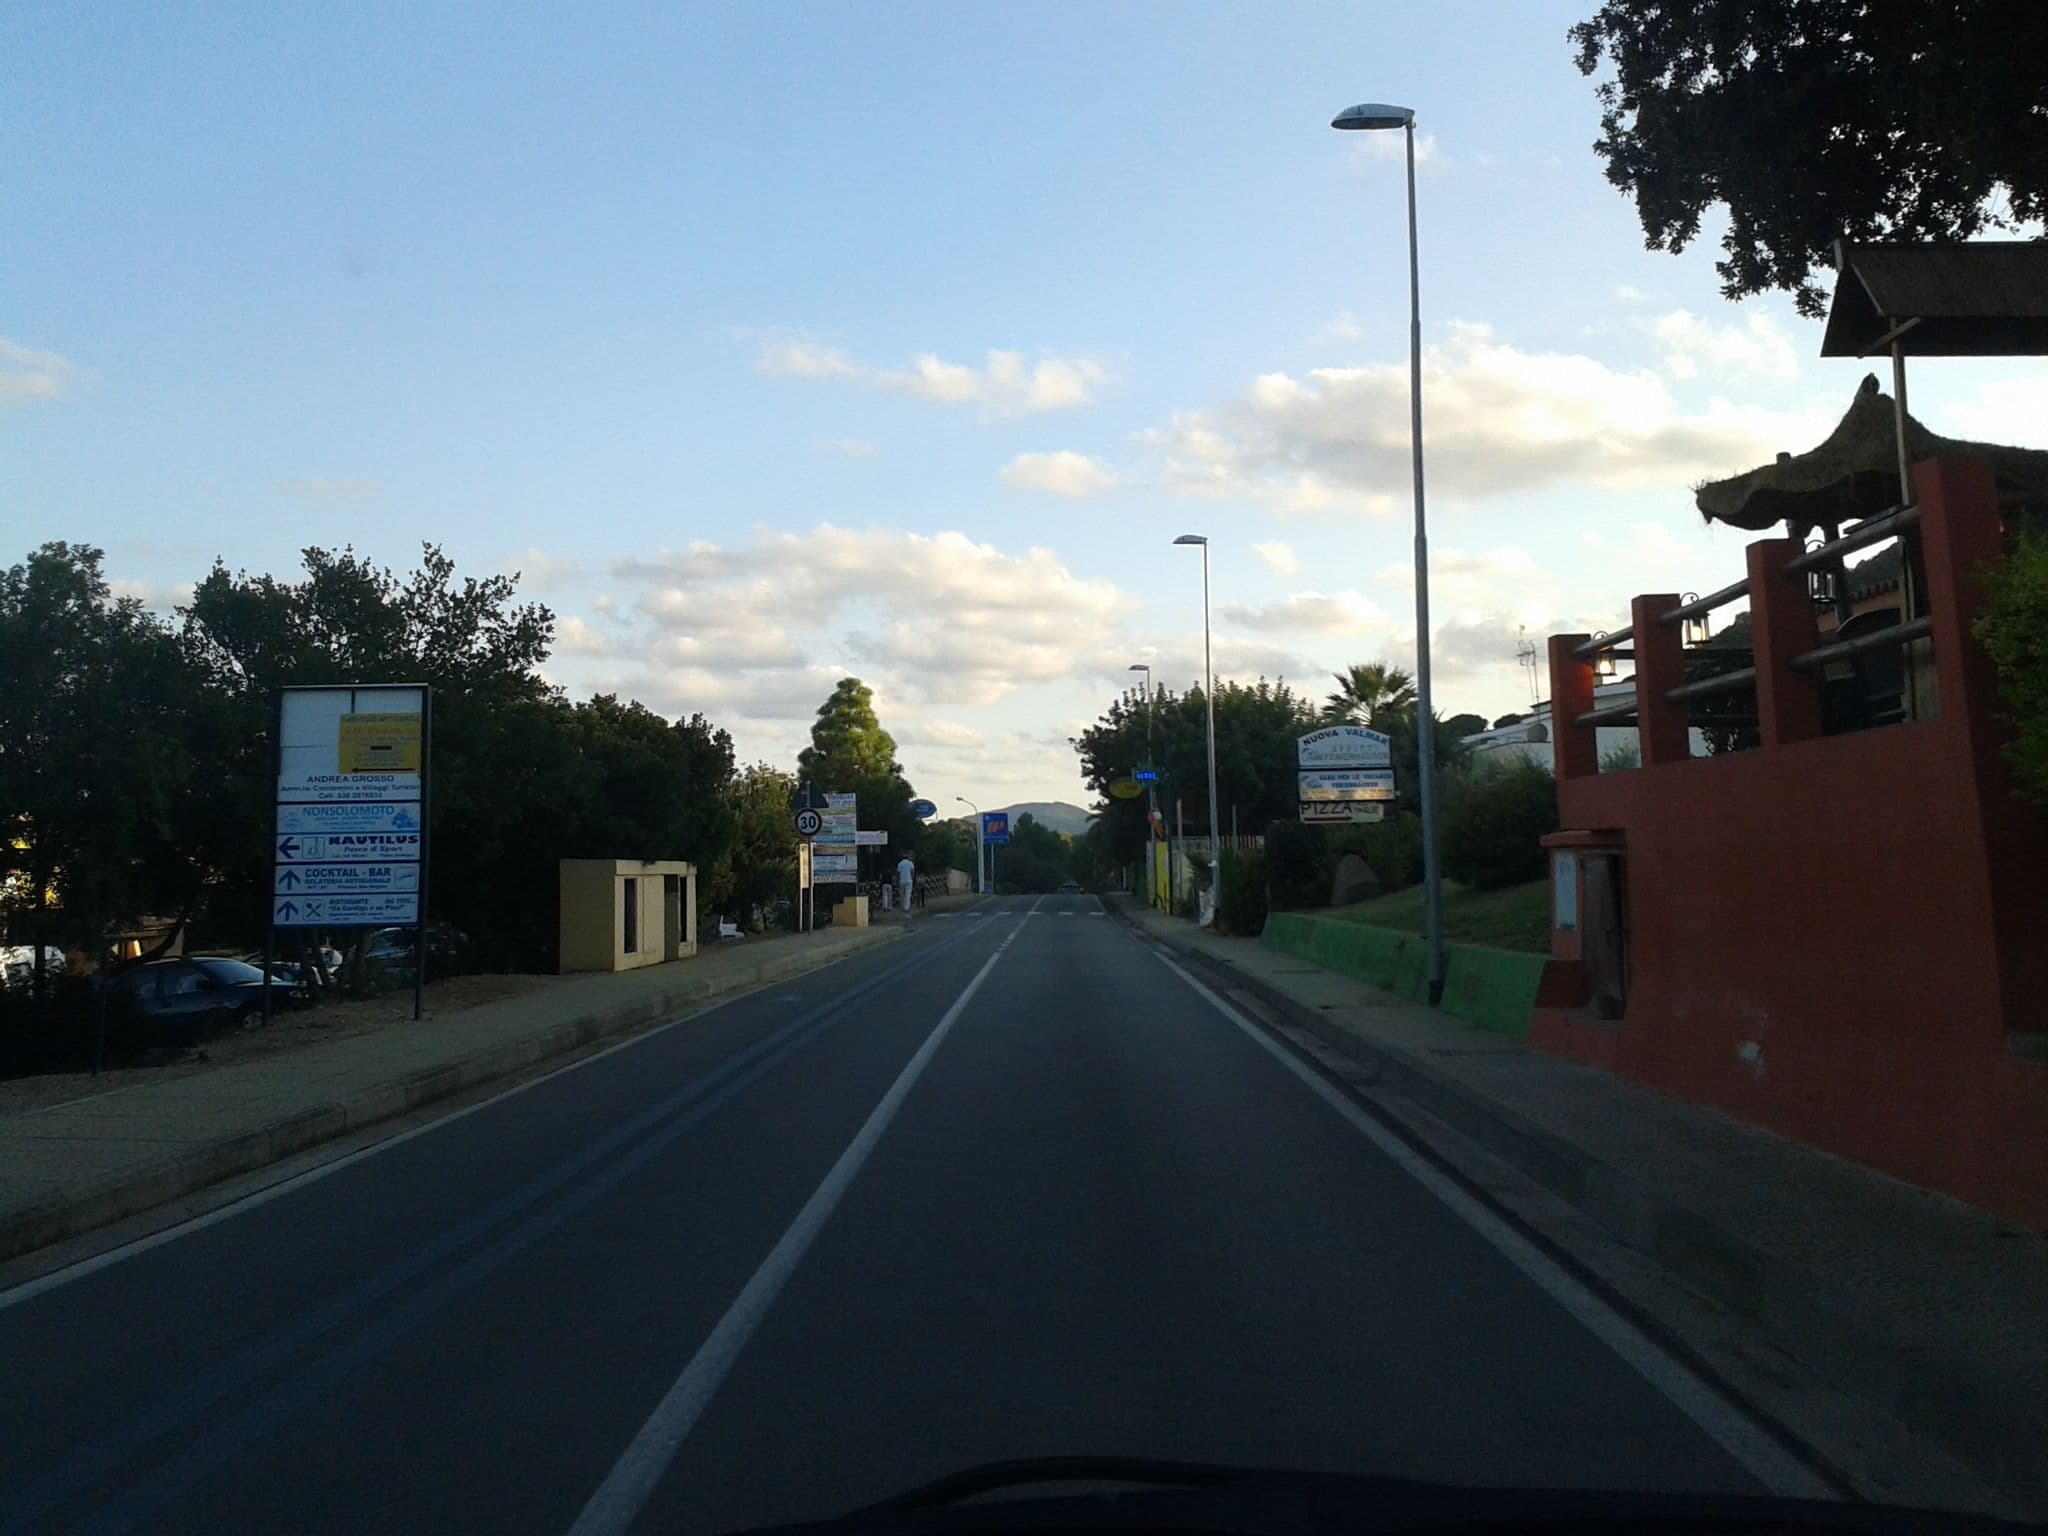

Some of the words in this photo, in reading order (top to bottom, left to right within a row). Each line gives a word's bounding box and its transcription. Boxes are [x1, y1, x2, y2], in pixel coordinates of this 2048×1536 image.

[1302, 729, 1339, 746] NUOVA
[306, 775, 349, 783] ANDREA
[351, 774, 395, 783] GROSSO
[362, 784, 388, 792] Villaggi
[303, 805, 395, 816] NONSOLOMOTO
[1300, 802, 1352, 815] PIZZA
[800, 815, 817, 829] 30
[328, 835, 419, 845] NAUTILUS
[379, 845, 403, 853] Sport
[304, 867, 360, 877] COCKTAIL
[368, 867, 391, 877] BAR
